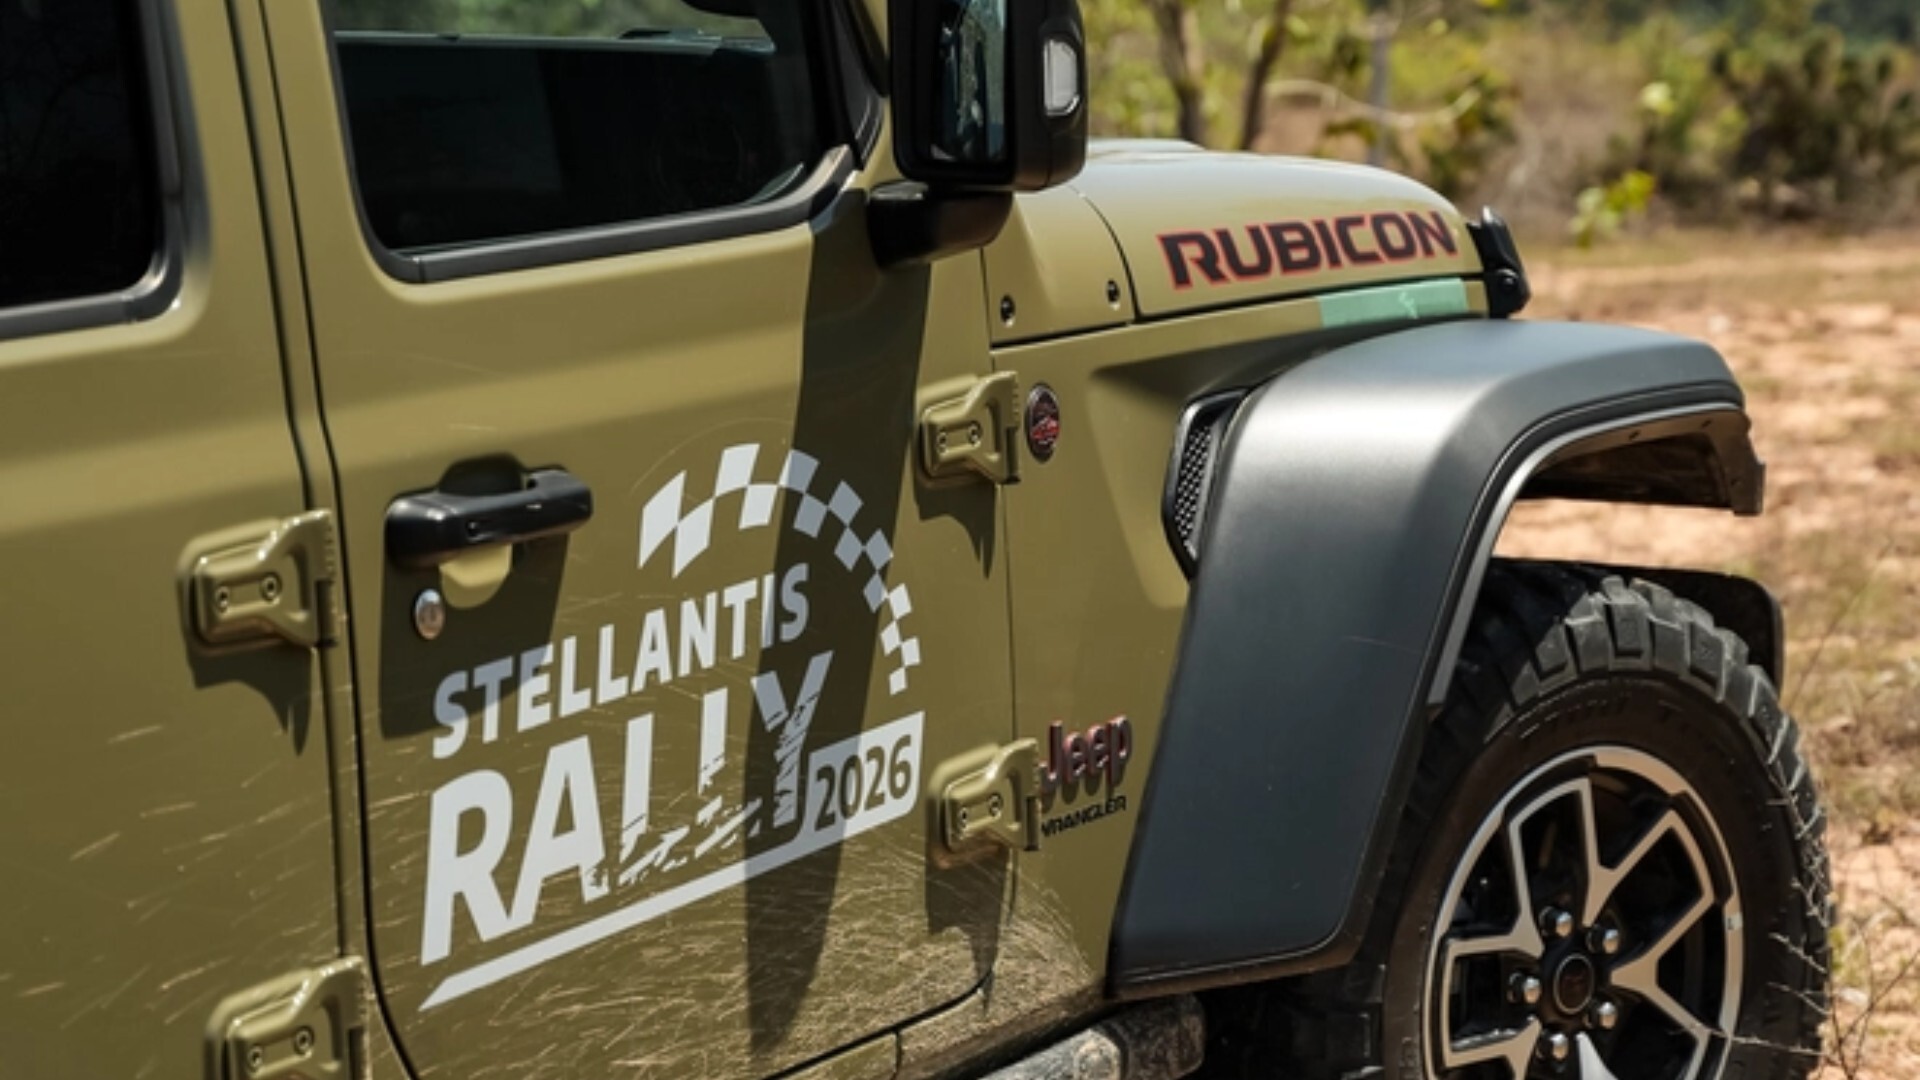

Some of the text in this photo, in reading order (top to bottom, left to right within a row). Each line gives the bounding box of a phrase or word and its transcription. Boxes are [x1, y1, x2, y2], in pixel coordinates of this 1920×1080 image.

[1158, 210, 1459, 290] RUBICON
[432, 563, 809, 759] STELLANTIS
[815, 733, 912, 832] 2026
[1040, 716, 1132, 796] Jeep
[420, 651, 834, 966] RALLY
